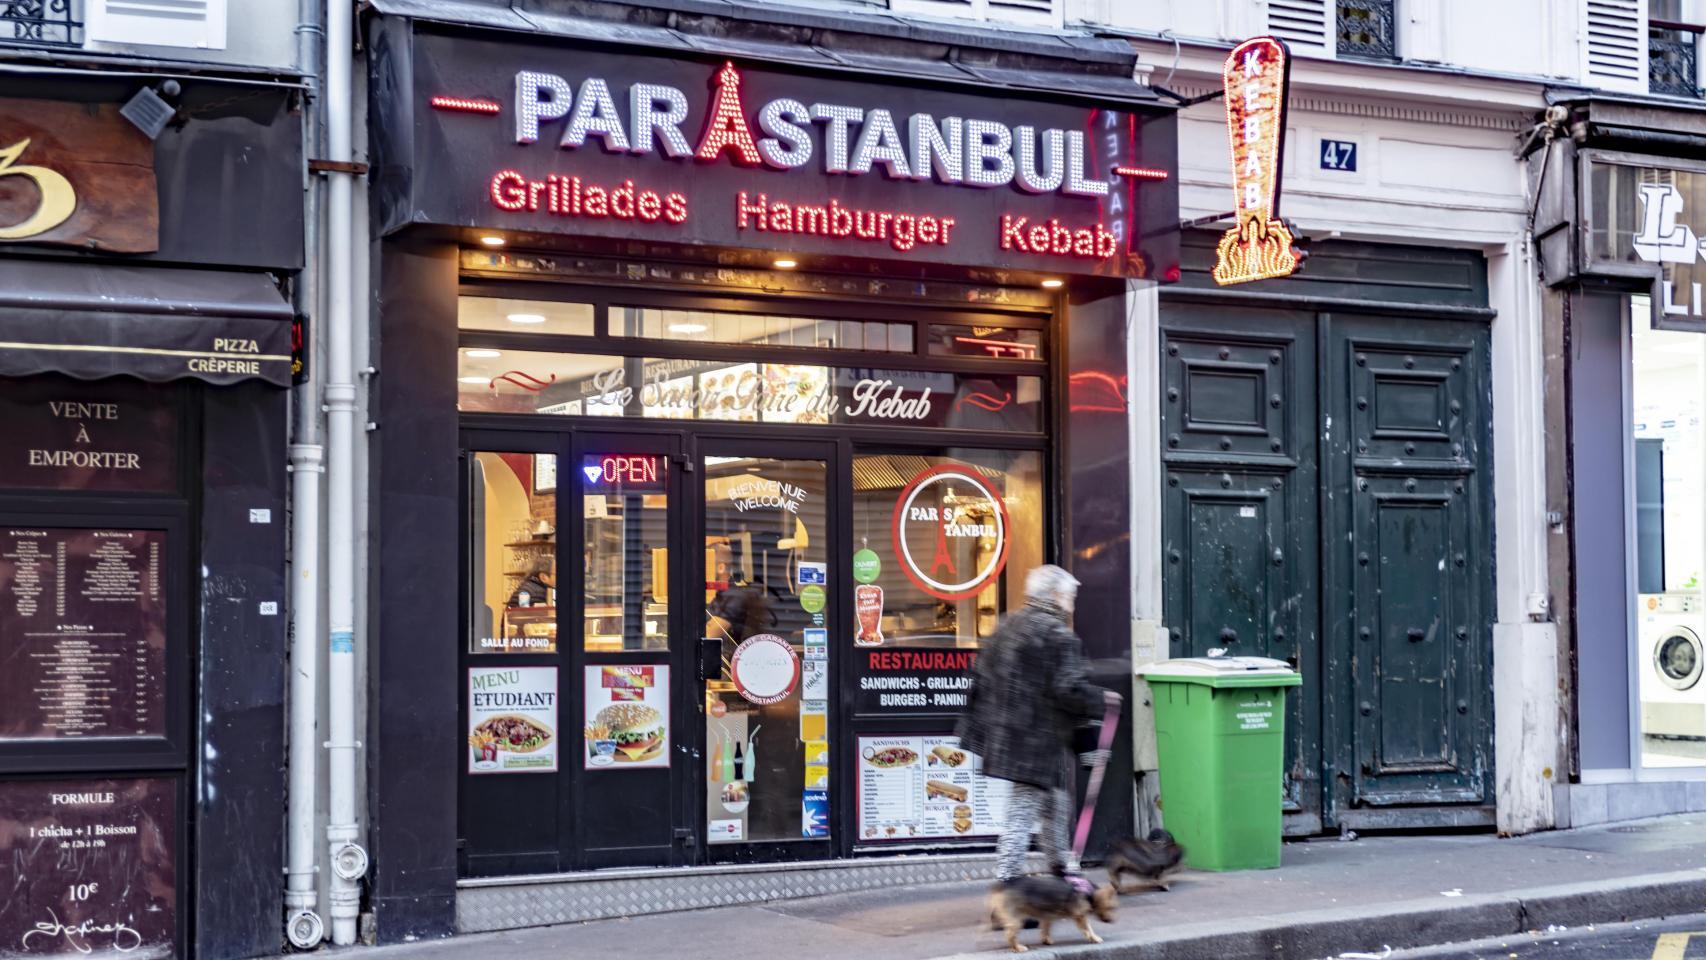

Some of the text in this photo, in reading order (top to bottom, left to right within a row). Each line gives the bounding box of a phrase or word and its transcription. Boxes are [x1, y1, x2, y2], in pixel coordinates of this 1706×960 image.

[1243, 48, 1263, 209] KEBAB
[1323, 141, 1354, 169] 47
[490, 168, 1118, 259] Grillades Hamburger Kebab
[213, 337, 260, 354] PIZZA
[188, 357, 260, 375] CRÊPERIE
[586, 367, 634, 408] Le
[639, 369, 720, 410] Savoir
[805, 383, 840, 415] du
[845, 379, 932, 420] Kebab
[49, 401, 119, 420] VENTE
[75, 423, 91, 443] À
[29, 449, 141, 469] EMPORTER
[603, 457, 657, 483] OPEN
[727, 480, 808, 502] BIENVENUE
[734, 495, 800, 514] WELCOME
[481, 637, 550, 648] SALLE AU FOND
[869, 652, 978, 670] RESTAURANT
[472, 670, 520, 691] MENU
[805, 671, 824, 690] HALAL
[860, 677, 920, 690] SANDWICHS
[473, 692, 556, 707] ETUDIANT
[880, 694, 927, 706] BURGERS
[52, 792, 115, 806] FORMULE
[38, 824, 73, 837] chicha
[95, 823, 137, 836] Boisson
[60, 840, 70, 849] de
[69, 882, 99, 901] 10€
